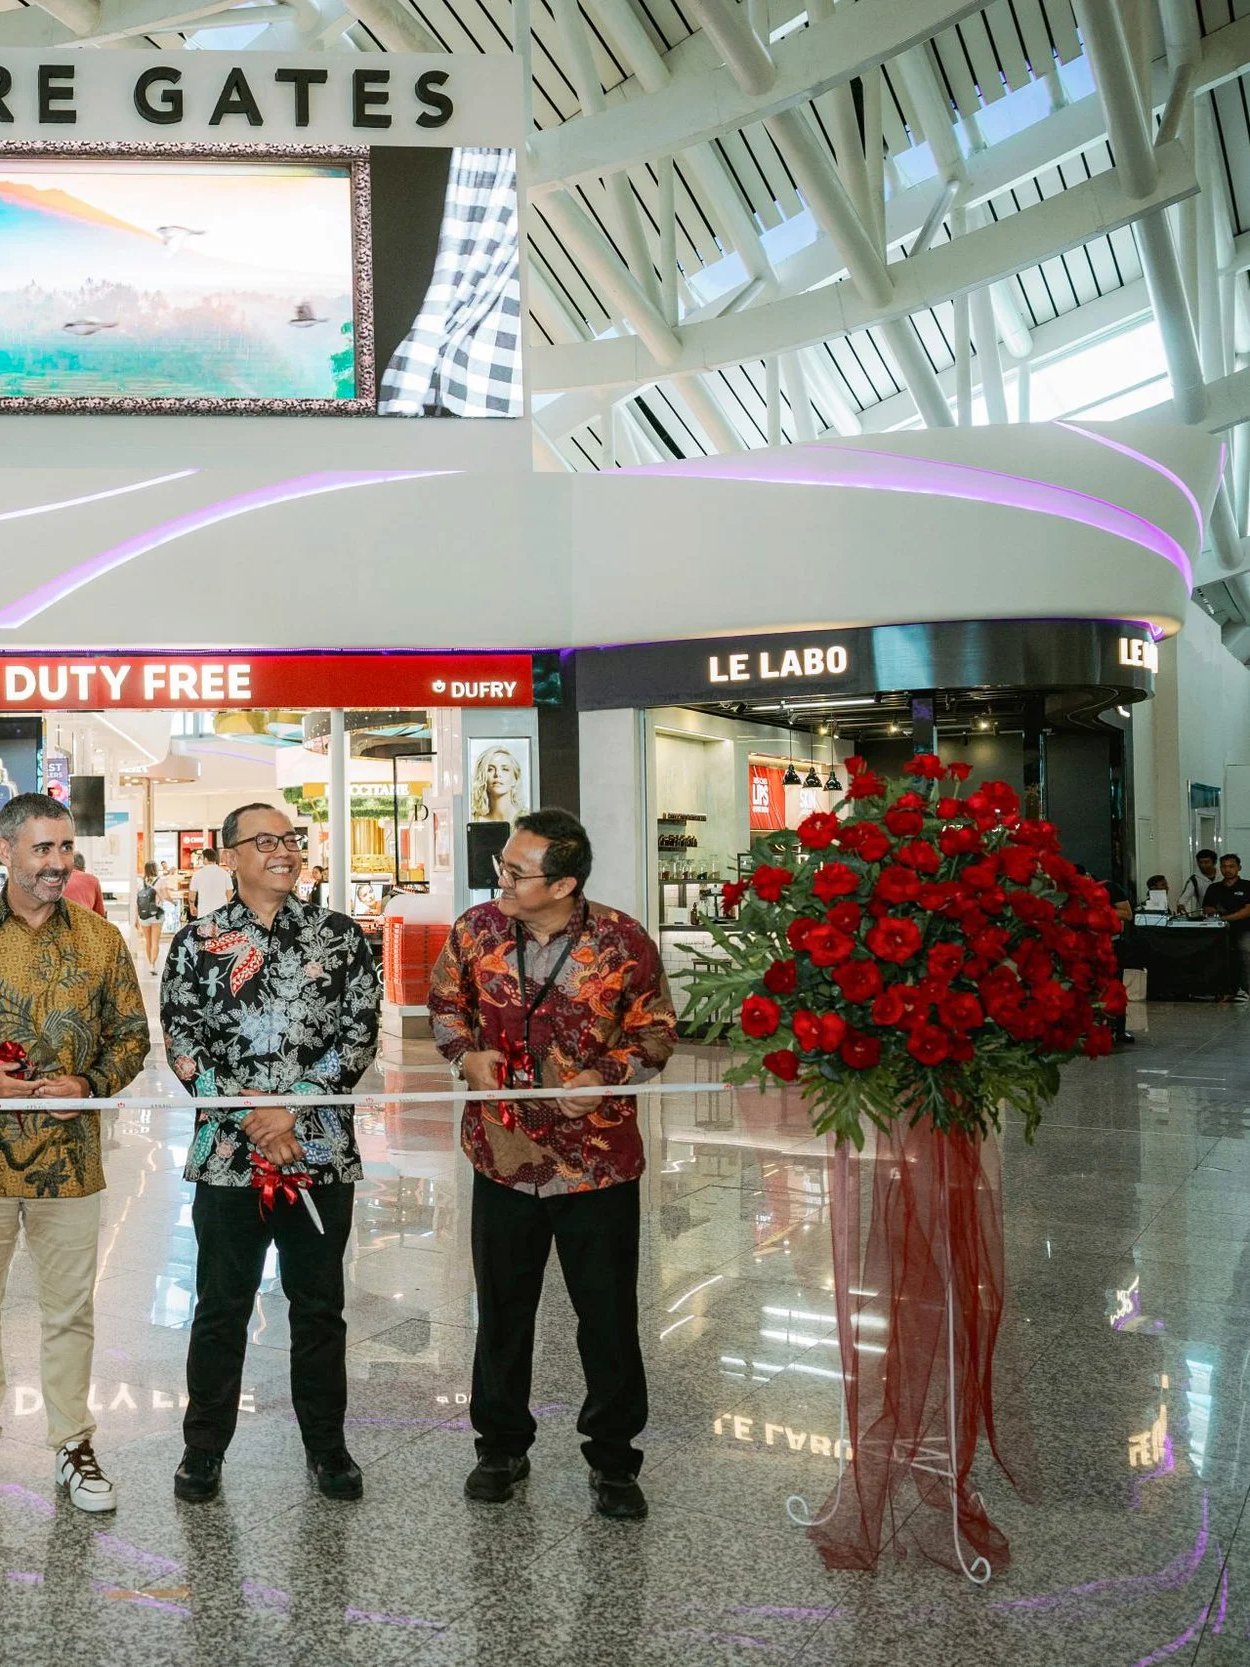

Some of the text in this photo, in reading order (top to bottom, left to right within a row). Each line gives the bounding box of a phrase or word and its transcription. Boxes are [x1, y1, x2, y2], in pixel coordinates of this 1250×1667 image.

[133, 65, 454, 129] GATES
[6, 664, 133, 701] DUTY
[144, 663, 252, 700] FREE
[708, 645, 848, 683] LE LABO
[450, 680, 518, 699] DUFRY
